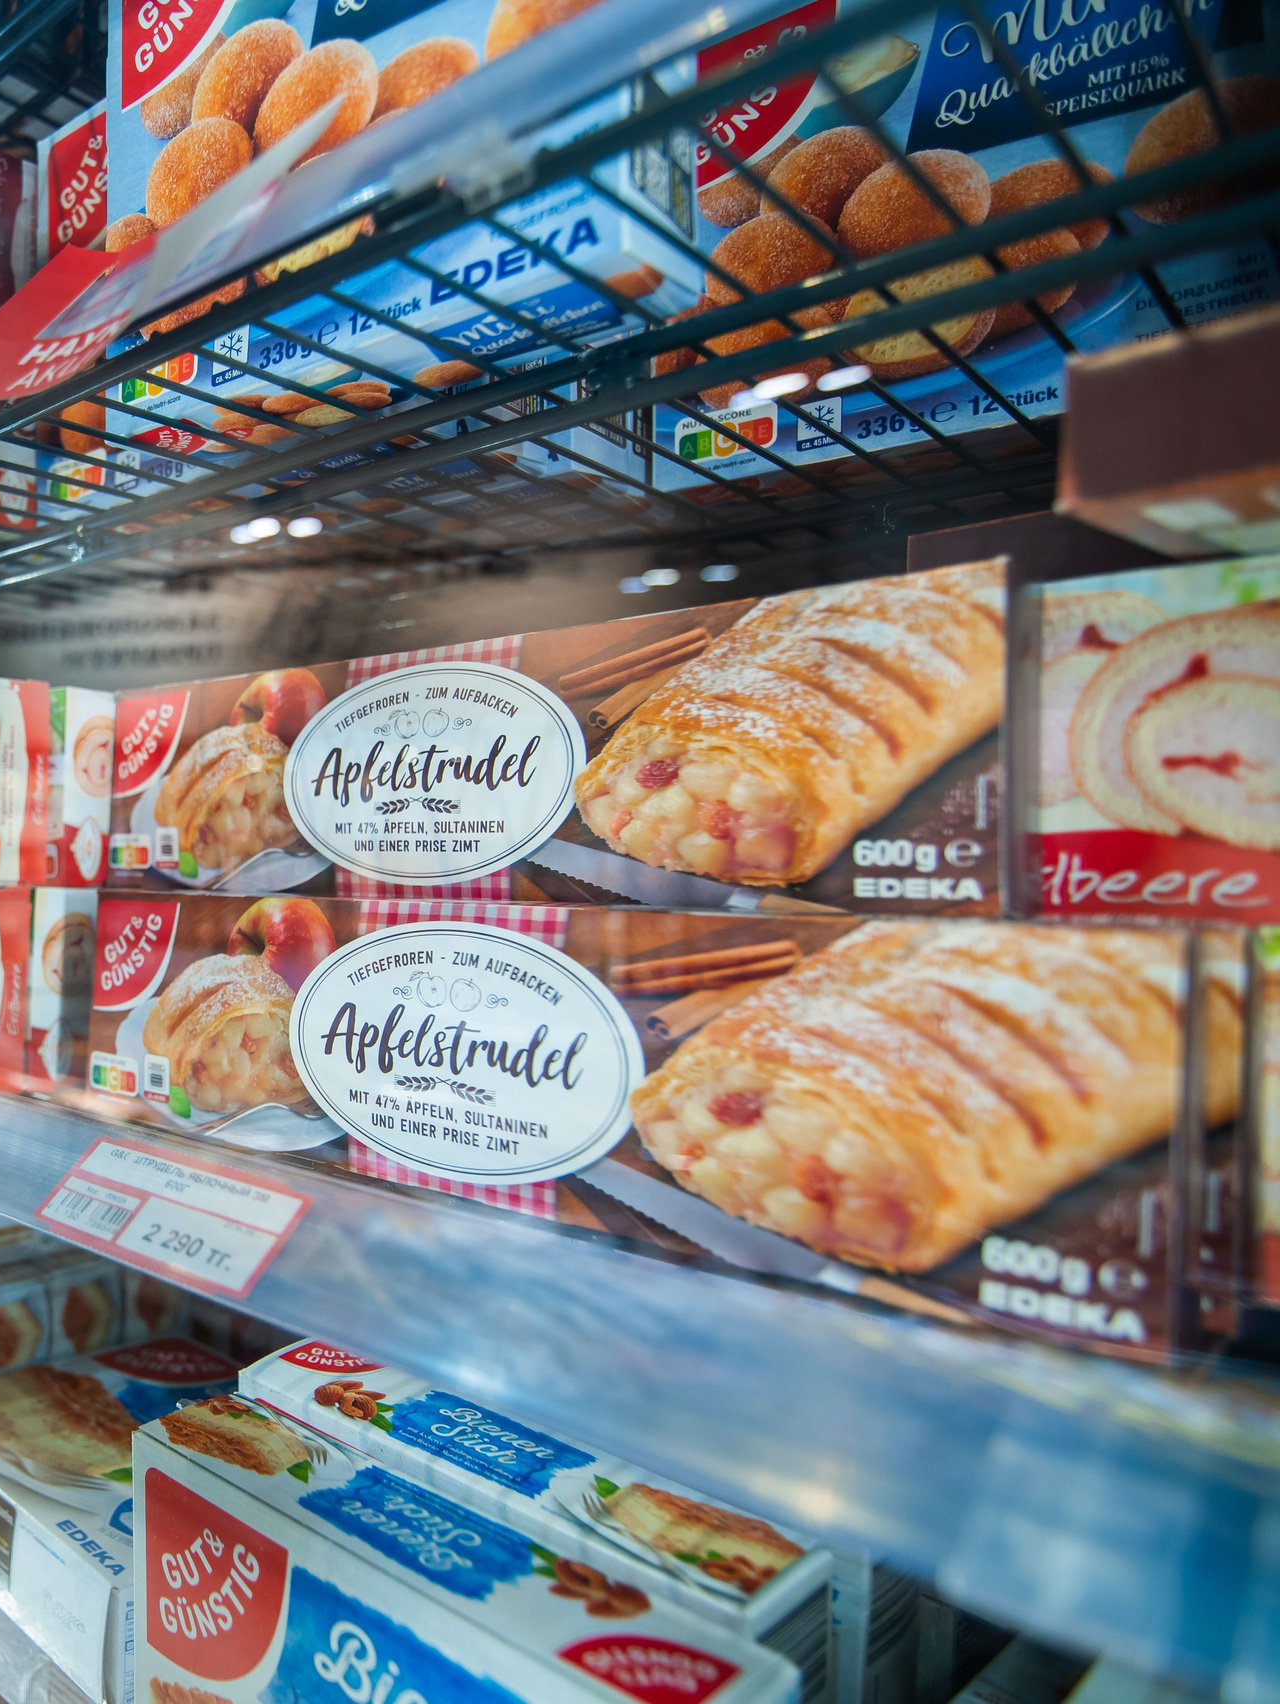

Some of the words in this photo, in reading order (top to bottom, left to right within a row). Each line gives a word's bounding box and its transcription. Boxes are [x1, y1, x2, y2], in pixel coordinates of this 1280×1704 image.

[135, 0, 200, 73] GÜN
[1044, 67, 1186, 118] SPEISEQUARK
[1087, 68, 1122, 88] MIT
[1129, 54, 1169, 76] 15%
[57, 152, 108, 244] GÜNS
[60, 135, 104, 211] GUT&
[430, 216, 600, 307] EDEKA
[1135, 269, 1270, 312] DEORZUCKER
[349, 311, 373, 337] 12
[968, 395, 1002, 416] 12
[813, 438, 822, 447] 45
[121, 708, 157, 754] GUT&
[335, 691, 410, 733] TIEFGEFROREN
[425, 687, 448, 700] ZUM
[452, 687, 519, 719] AUFBACKEN
[118, 703, 174, 779] GÜNSTIG
[311, 735, 541, 808] Apfelstrudel
[335, 823, 352, 834] MIT
[358, 822, 379, 834] 47%
[384, 819, 428, 836] ÄPFELN,
[434, 820, 505, 834] SULTANINEN
[354, 840, 374, 852] UND
[379, 840, 410, 852] EINER
[415, 840, 447, 852] PRISE
[452, 840, 480, 853] ZIMT
[853, 838, 939, 873] 600g
[1040, 852, 1269, 907] dbeere
[853, 877, 984, 901] EDEKA
[100, 913, 162, 991] GÜNSTIG
[104, 915, 144, 964] GUT&
[347, 950, 433, 986] TIEFGEFROREN
[452, 952, 480, 968] ZUM
[484, 958, 564, 1007] AUFBACKEN
[321, 1001, 588, 1090] Apfelstrudel
[349, 1089, 370, 1105] MIT
[375, 1094, 400, 1111] 47%
[406, 1096, 458, 1123] ÄPFELN,
[464, 1110, 548, 1139] SULTANINEN
[371, 1113, 395, 1130] UND
[400, 1119, 437, 1139] EINER
[443, 1128, 480, 1148] PRISE
[486, 1135, 520, 1156] ZIMT
[142, 1223, 162, 1243] 2
[161, 1230, 204, 1258] 290
[981, 1235, 1091, 1296] 600g
[978, 1279, 1147, 1344] EDEKA
[295, 1351, 374, 1368] GÜNSTIG
[430, 1423, 518, 1465] Stich
[438, 1407, 555, 1460] Bienen
[56, 1519, 126, 1577] EDEKA
[161, 1528, 225, 1589] GUT&
[158, 1543, 261, 1640] GÜNSTIG
